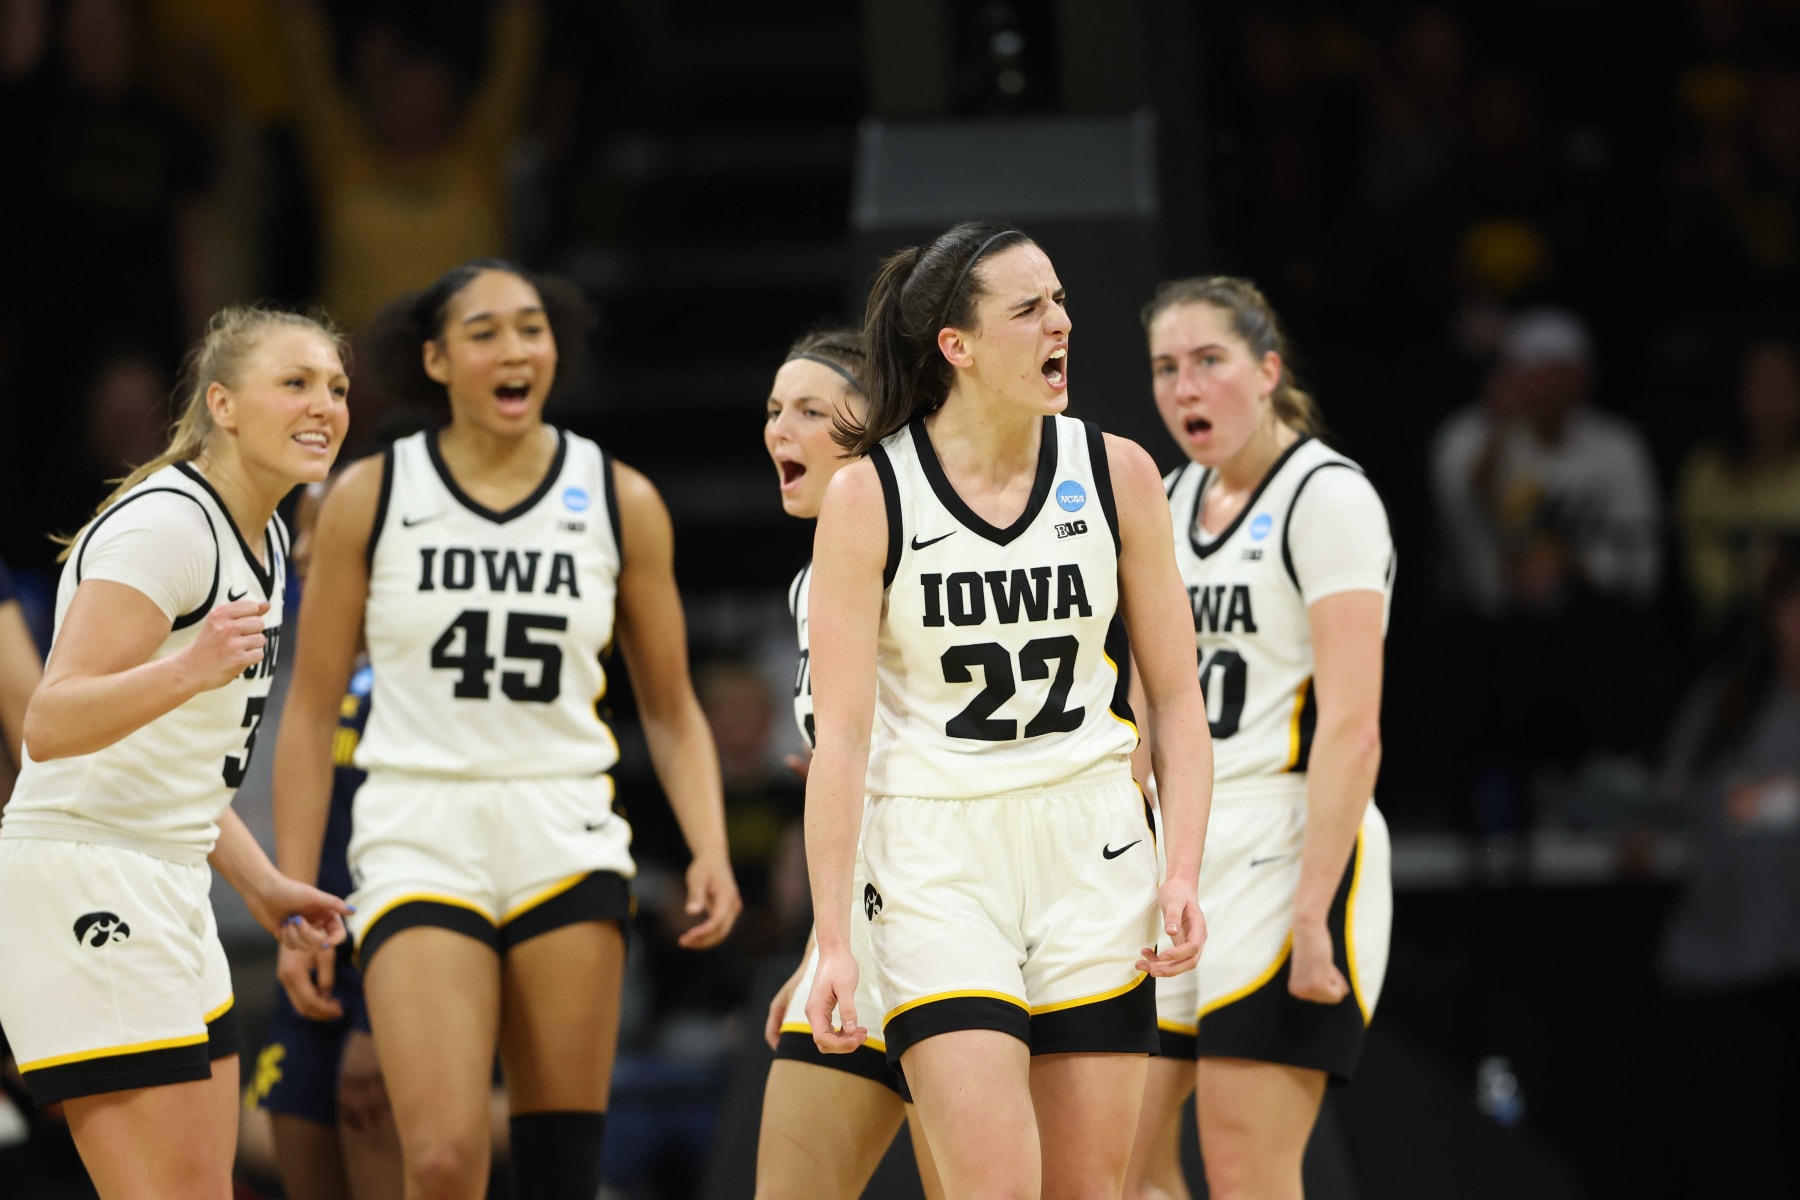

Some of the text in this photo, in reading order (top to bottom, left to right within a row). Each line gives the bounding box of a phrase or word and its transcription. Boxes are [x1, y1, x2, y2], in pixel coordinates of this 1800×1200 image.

[1060, 495, 1085, 504] NCAA
[418, 547, 581, 599] IOWA
[920, 563, 1093, 627] IOWA
[1188, 585, 1257, 633] WA
[430, 610, 568, 704] 45
[940, 634, 1086, 742] 22
[1197, 650, 1247, 739] 0
[222, 697, 267, 788] 3
